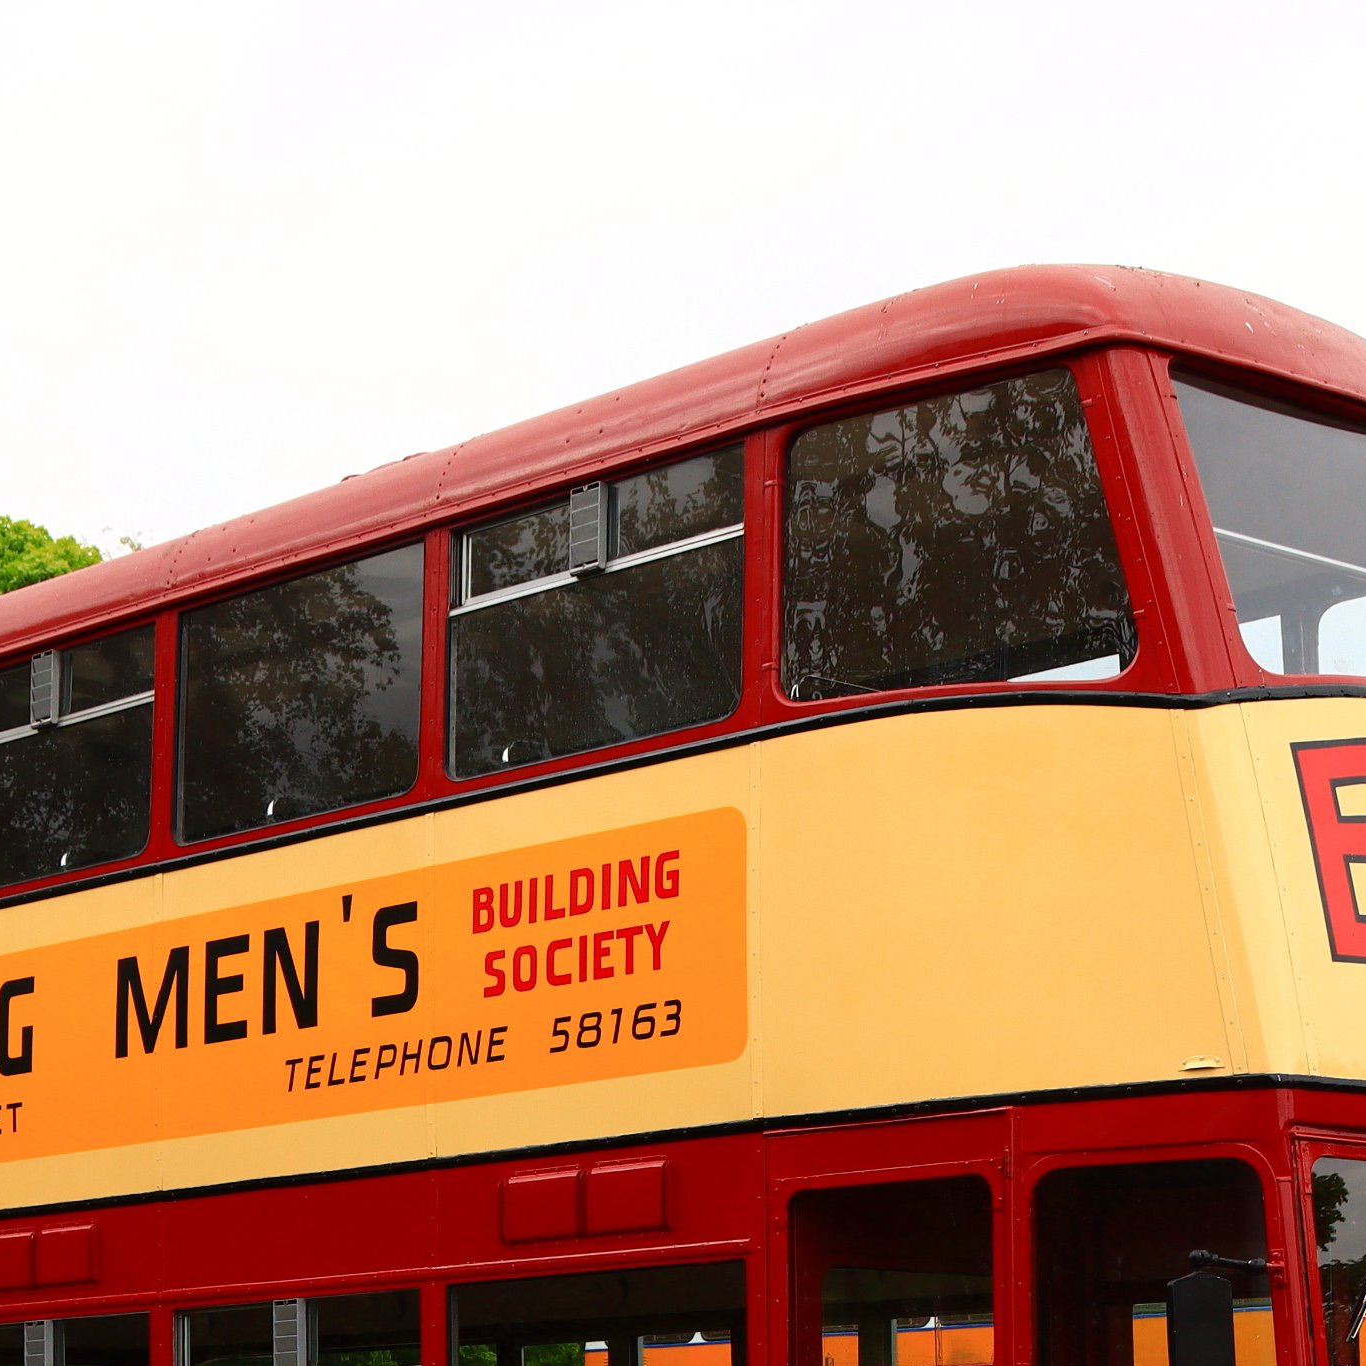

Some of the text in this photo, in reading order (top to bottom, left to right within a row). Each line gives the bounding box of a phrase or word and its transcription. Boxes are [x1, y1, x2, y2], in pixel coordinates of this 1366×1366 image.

[472, 849, 681, 934] BUILDING
[115, 894, 419, 1059] MEN'S
[483, 920, 671, 999] SOCIETY
[285, 999, 683, 1093] TELEPHONE 58163
